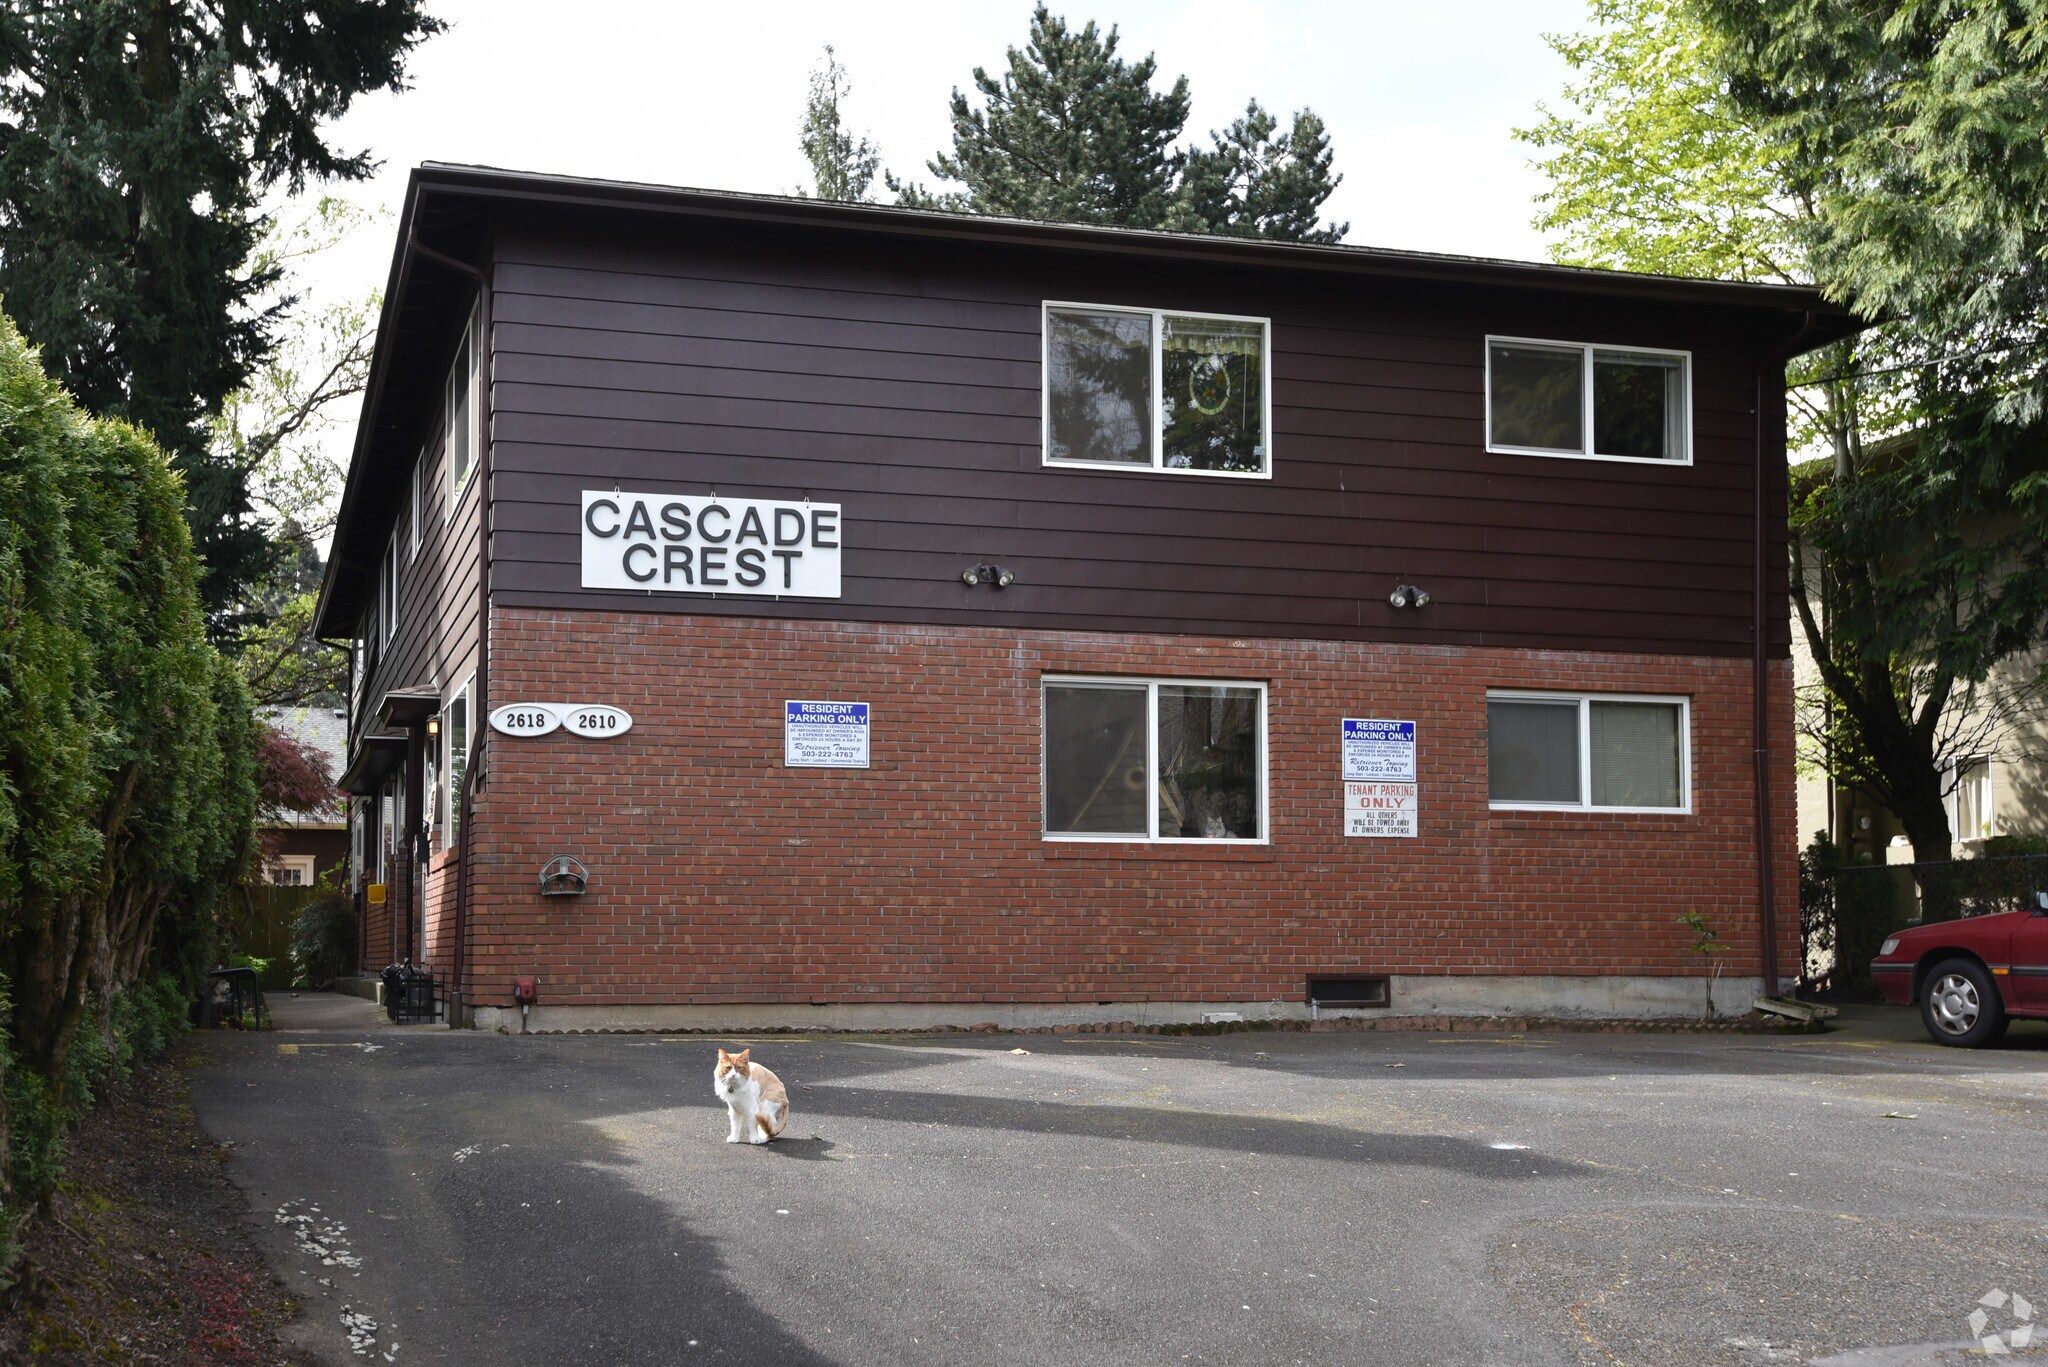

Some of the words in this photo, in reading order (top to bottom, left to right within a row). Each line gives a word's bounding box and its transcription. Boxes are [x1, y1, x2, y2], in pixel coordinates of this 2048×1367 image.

[586, 499, 839, 548] CASCADE
[623, 543, 803, 588] CREST
[802, 704, 853, 714] RESIDENT
[507, 713, 545, 727] 2618
[578, 714, 616, 729] 2610
[788, 713, 835, 723] PARKING
[838, 715, 866, 724] ONLY
[1356, 722, 1401, 731] RESIDENT
[1345, 731, 1386, 740] PARKING
[1388, 732, 1413, 740] ONLY
[833, 743, 860, 753] Towing
[1384, 759, 1408, 768] Towing
[1348, 785, 1377, 795] TENANT
[1381, 785, 1414, 796] PARKING
[1361, 797, 1405, 808] ONLY
